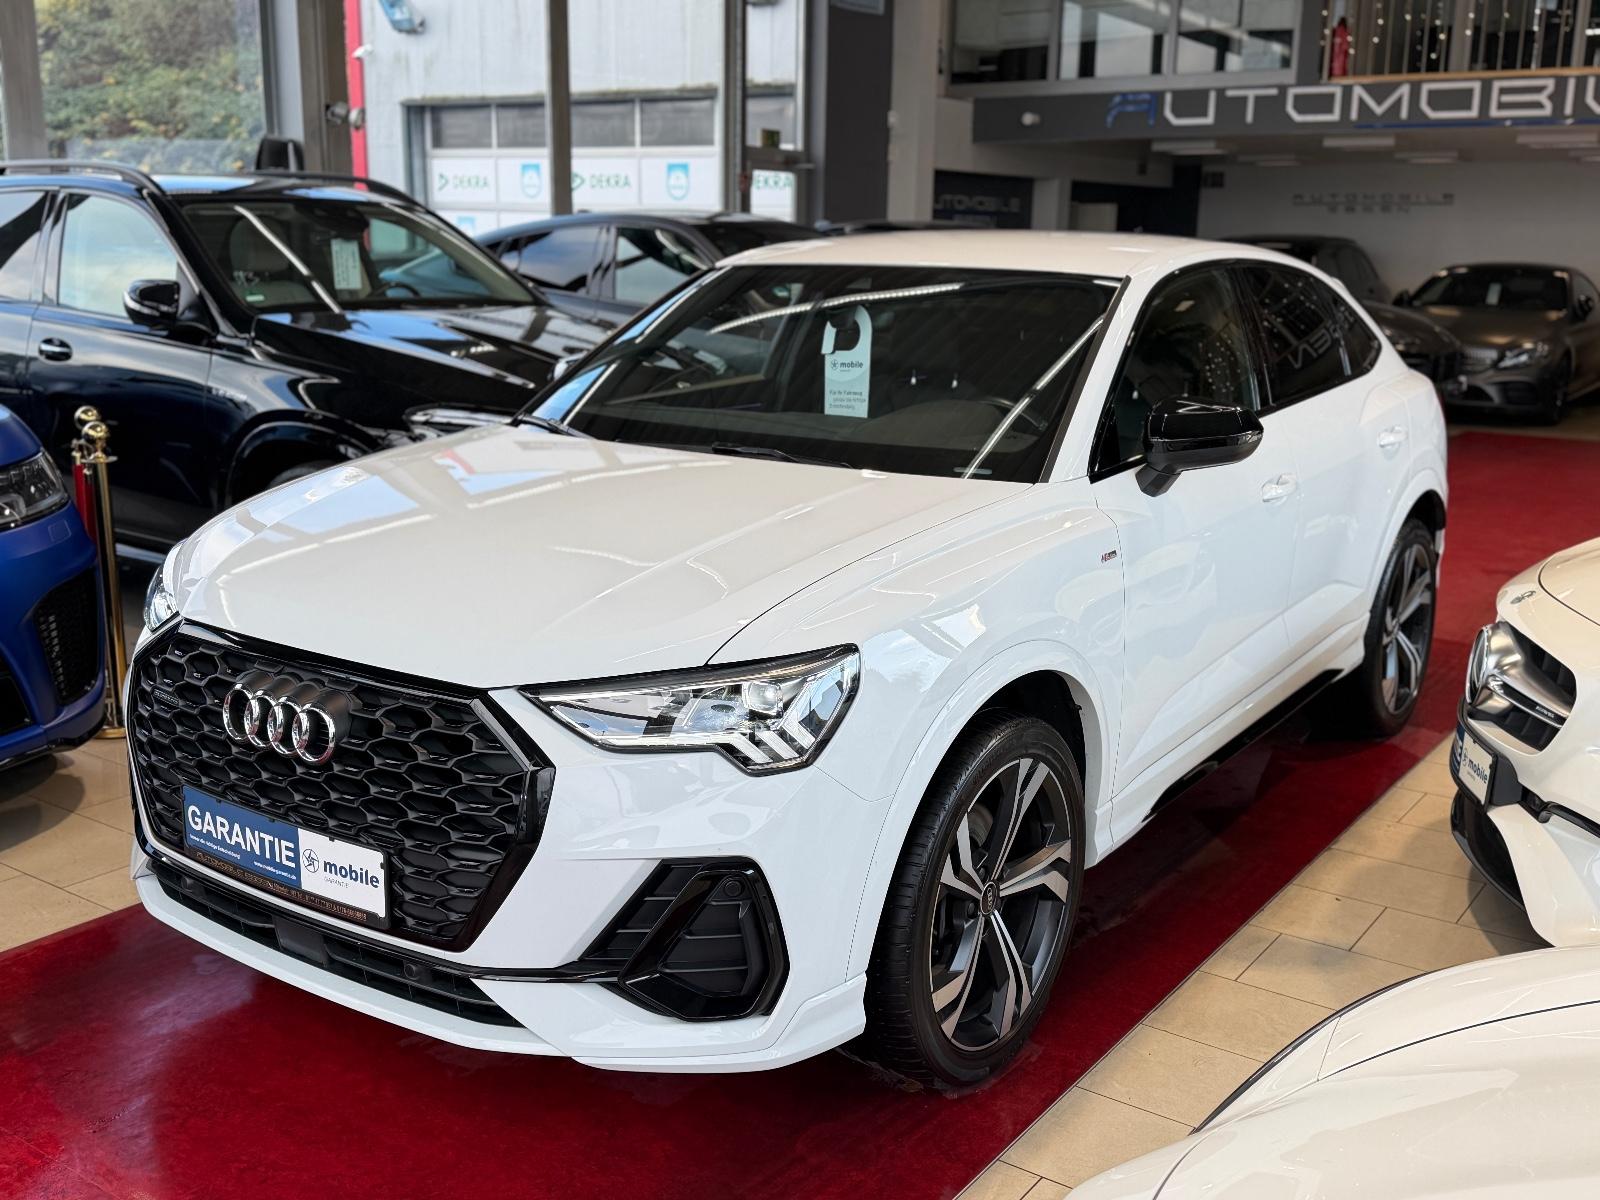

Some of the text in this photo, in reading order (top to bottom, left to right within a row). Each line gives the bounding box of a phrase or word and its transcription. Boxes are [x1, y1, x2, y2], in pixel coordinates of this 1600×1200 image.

[452, 174, 489, 189] DEKRA
[589, 173, 632, 189] DEKRA
[753, 172, 794, 190] EKRA
[839, 360, 864, 369] mobile
[1467, 758, 1488, 784] mobile
[187, 804, 296, 868] GARANTIE
[323, 860, 380, 889] mobile
